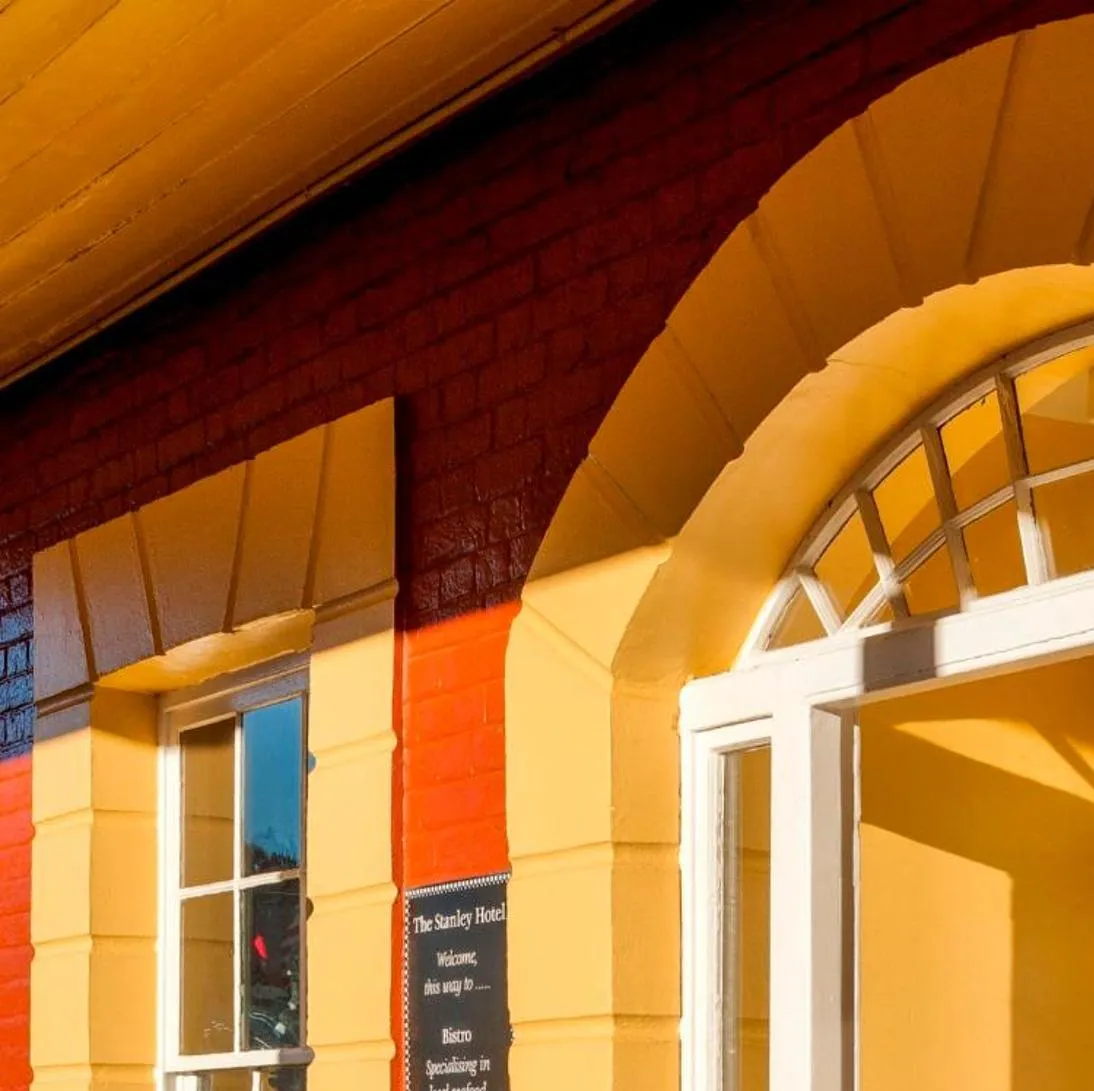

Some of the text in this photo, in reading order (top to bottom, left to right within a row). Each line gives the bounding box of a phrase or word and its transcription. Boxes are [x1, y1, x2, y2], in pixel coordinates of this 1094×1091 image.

[413, 902, 506, 934] The Stanley Hotel
[436, 950, 478, 967] Welcome,
[424, 979, 441, 997] this
[443, 980, 462, 997] way
[464, 975, 474, 991] to
[442, 1026, 472, 1044] Bistro
[426, 1056, 491, 1080] Specialising in
